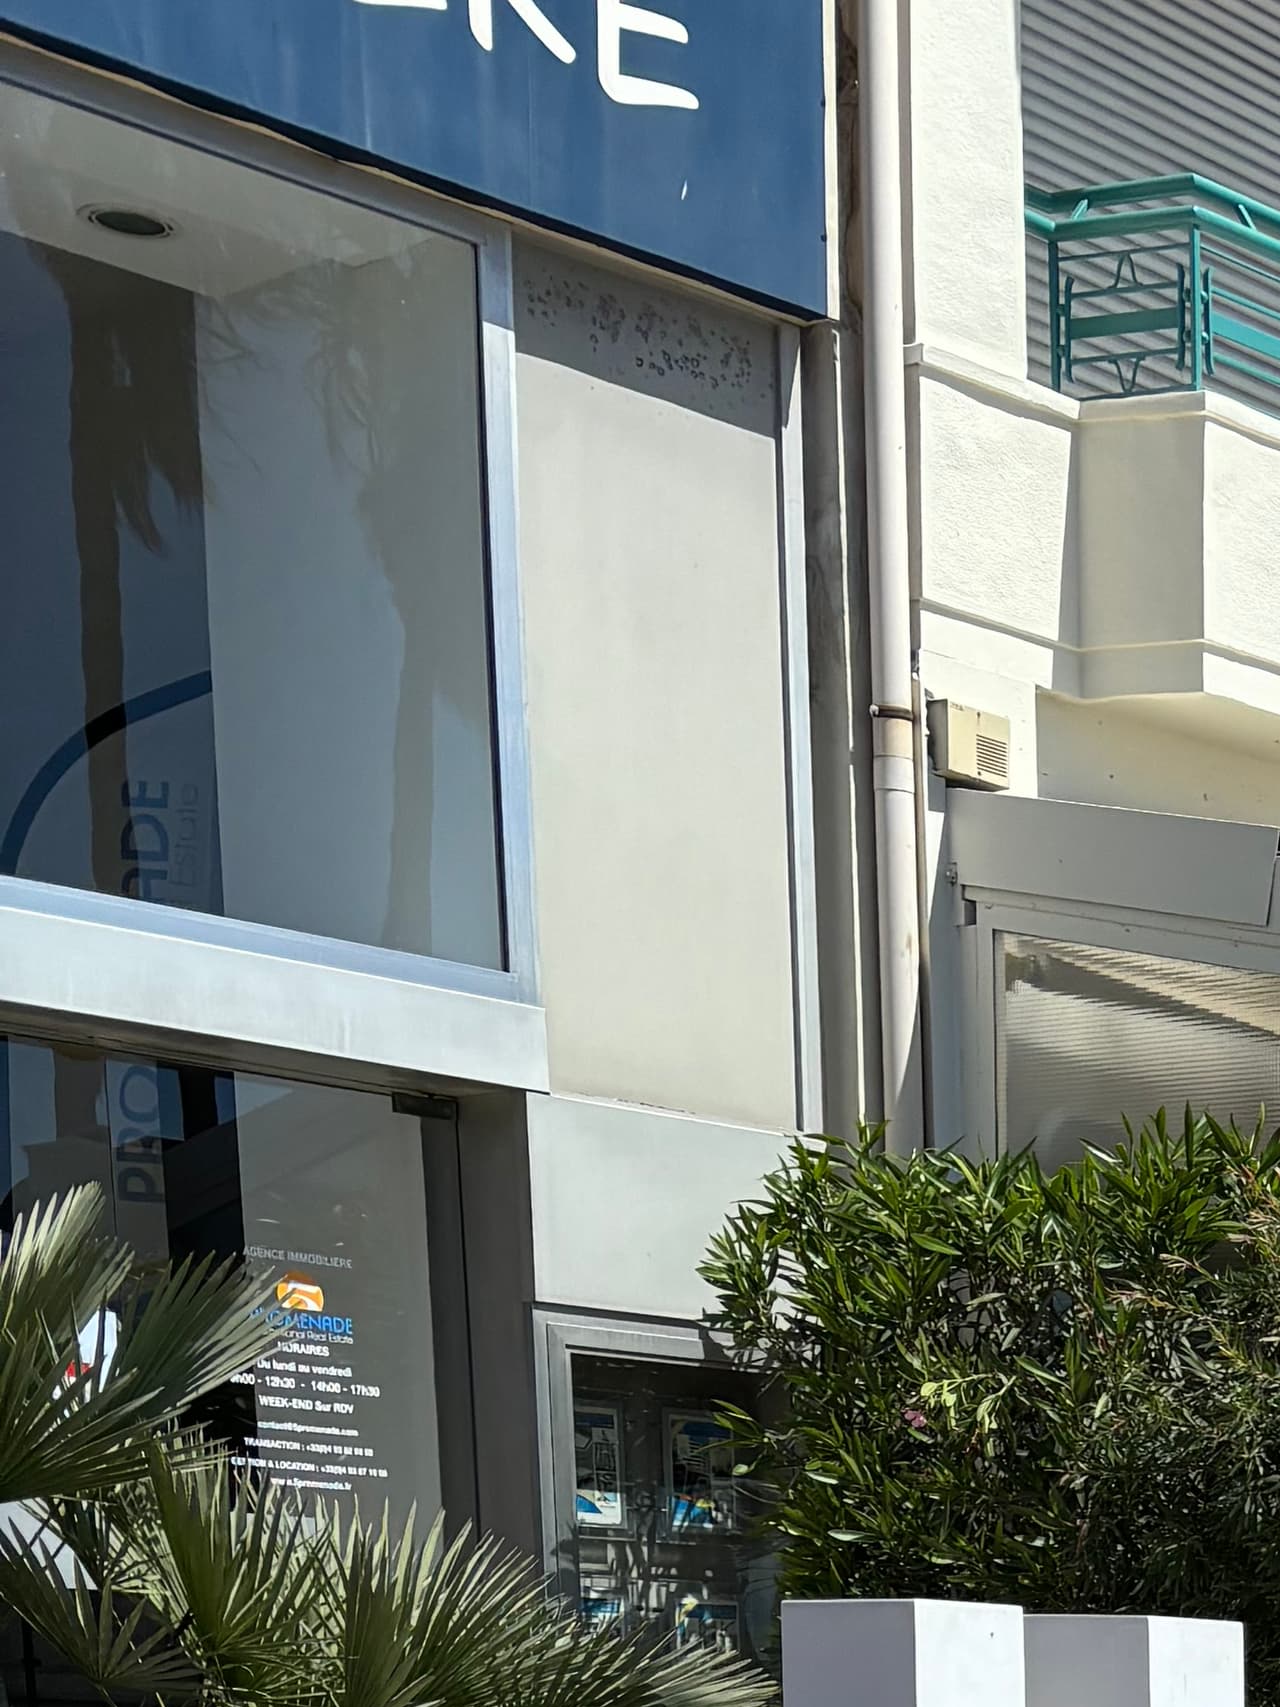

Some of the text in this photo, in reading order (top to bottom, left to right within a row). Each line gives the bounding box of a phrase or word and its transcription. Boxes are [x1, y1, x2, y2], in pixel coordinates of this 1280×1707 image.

[243, 1246, 284, 1261] AGENCE
[312, 1365, 353, 1377] vendredi
[258, 1394, 313, 1410] WEEK-END
